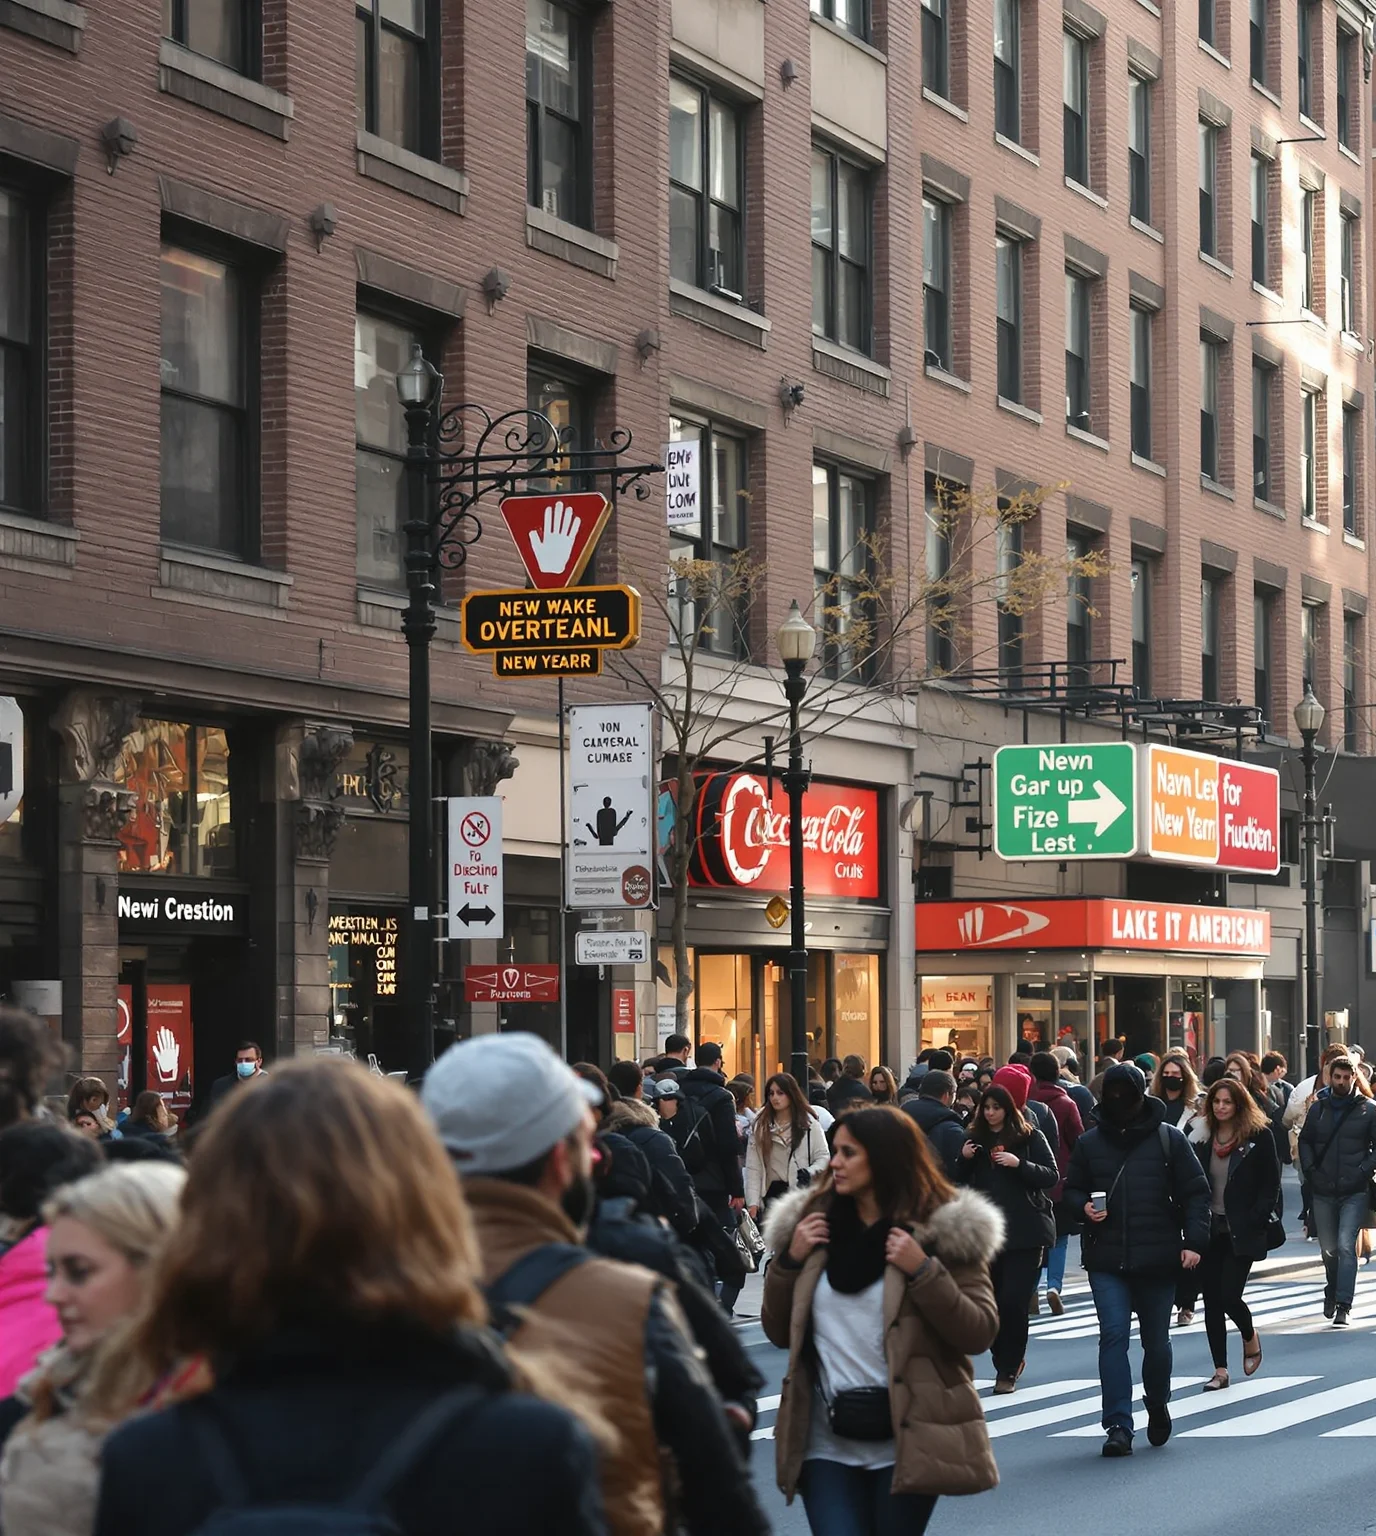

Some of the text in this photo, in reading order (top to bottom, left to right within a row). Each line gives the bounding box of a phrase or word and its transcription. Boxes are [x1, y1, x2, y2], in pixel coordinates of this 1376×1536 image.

[500, 599, 597, 617] NEW WAKE
[480, 617, 617, 641] OVERTEANL
[503, 654, 591, 670] NEW YEARR
[1011, 775, 1084, 799] Gar up
[1223, 772, 1243, 807] for
[1013, 806, 1060, 829] Fize
[1154, 801, 1184, 837] New
[822, 805, 866, 856] Cola
[1031, 832, 1076, 853] Lest
[118, 896, 159, 919] Newi
[1112, 908, 1158, 941] LAKE
[1165, 911, 1182, 941] IT
